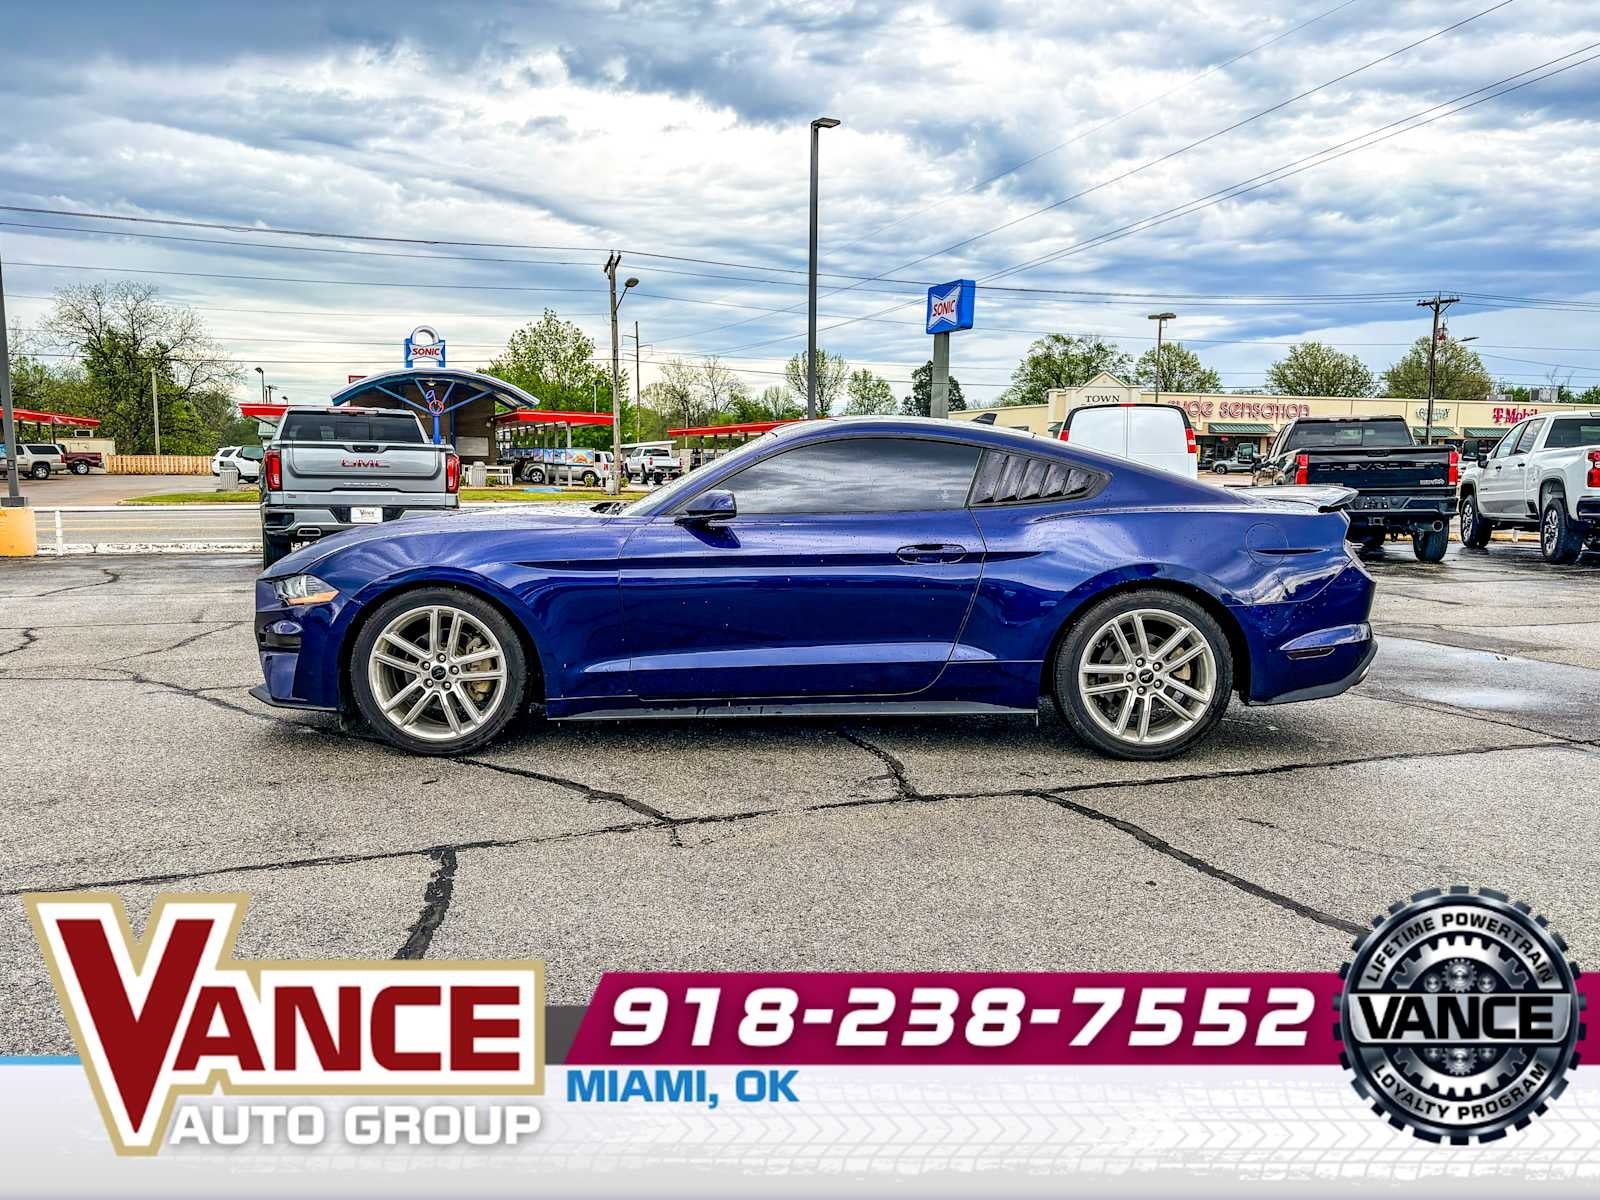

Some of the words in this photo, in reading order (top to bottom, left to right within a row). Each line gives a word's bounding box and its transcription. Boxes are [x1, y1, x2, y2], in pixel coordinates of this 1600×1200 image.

[932, 300, 956, 317] SONIC
[412, 347, 440, 356] SONIC
[1085, 395, 1120, 403] TOWN
